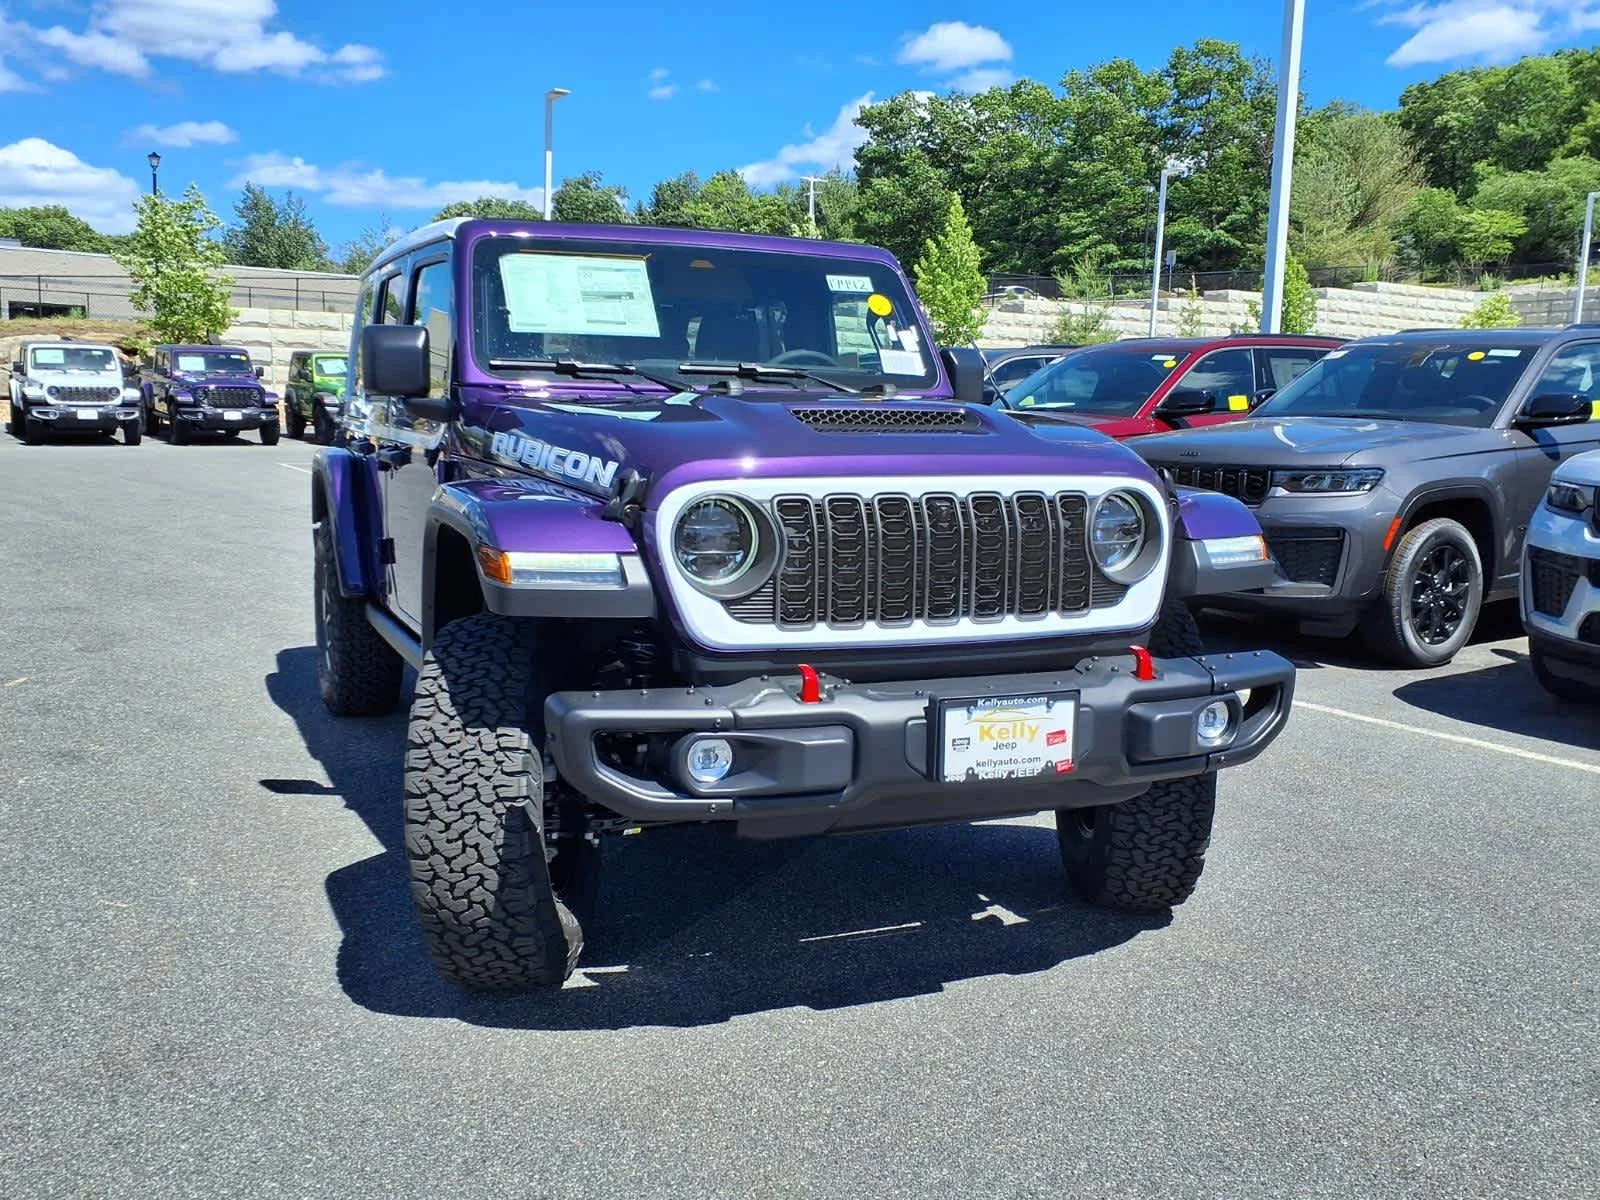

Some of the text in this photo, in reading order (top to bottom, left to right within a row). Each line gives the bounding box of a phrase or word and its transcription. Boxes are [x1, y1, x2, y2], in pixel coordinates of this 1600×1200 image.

[490, 431, 619, 488] RUBICON
[977, 696, 1048, 707] Kellyauto.com
[979, 722, 1040, 743] Kelly
[992, 741, 1017, 751] Jeep
[976, 756, 1041, 768] kellyauto.com
[978, 767, 1008, 780] Kelly
